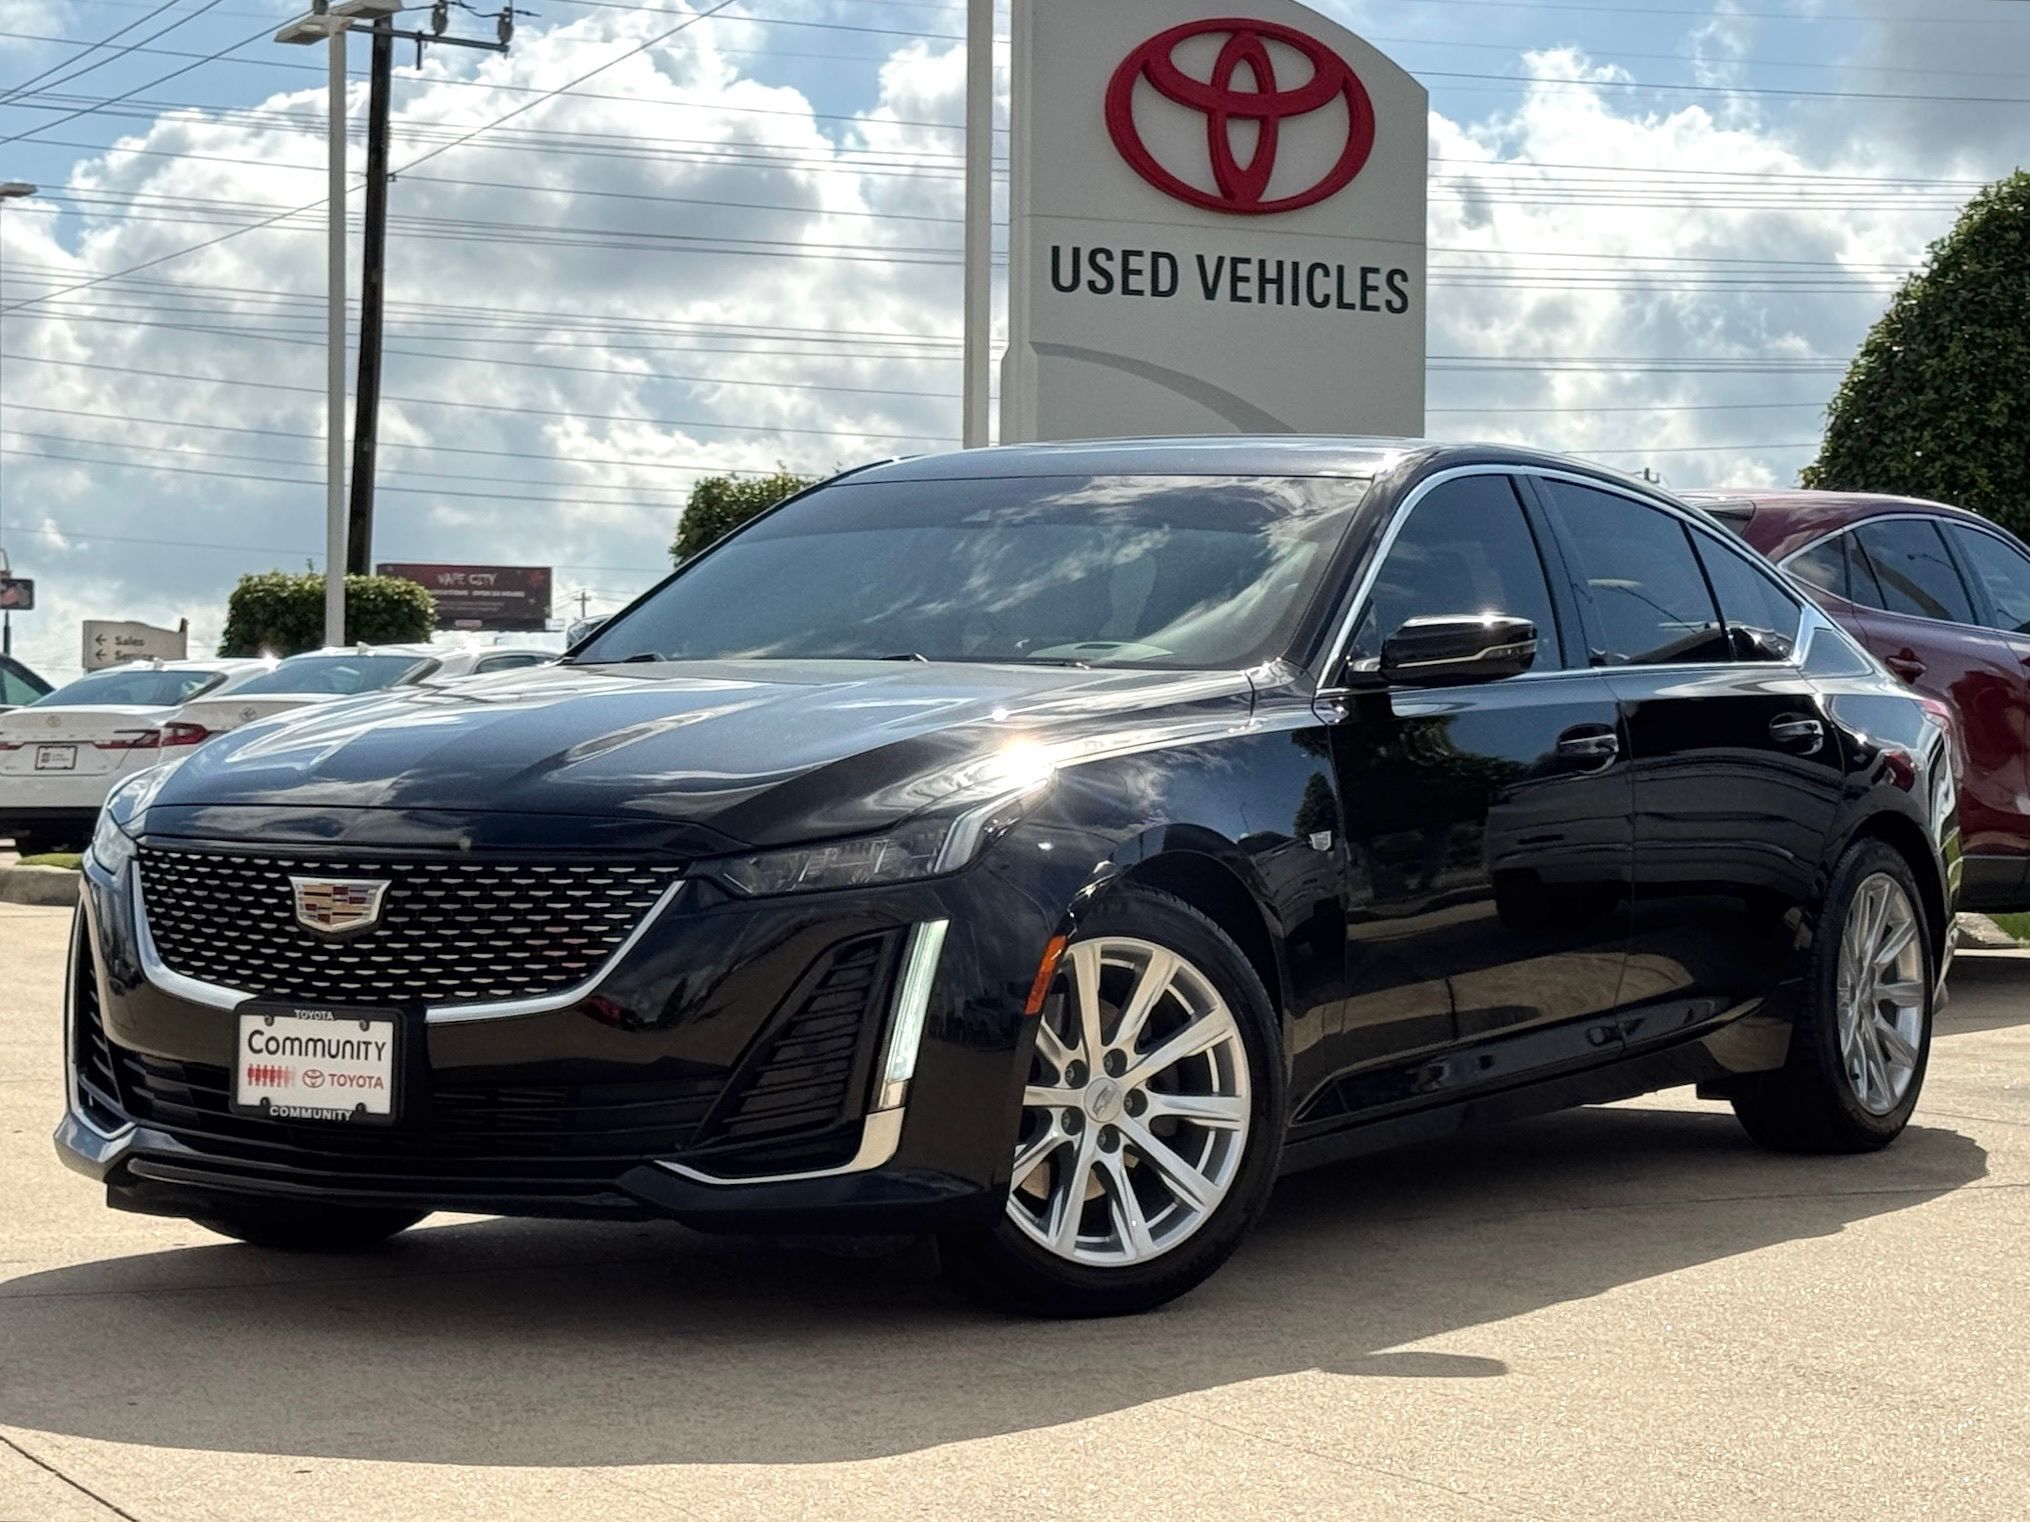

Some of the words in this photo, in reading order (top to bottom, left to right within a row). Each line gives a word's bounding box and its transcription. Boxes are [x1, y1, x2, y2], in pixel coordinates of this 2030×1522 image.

[1050, 245, 1179, 298] USED
[1196, 254, 1409, 314] VEHICLES
[468, 573, 498, 587] CITY
[115, 635, 145, 647] Sales
[294, 1009, 335, 1021] TOYOTA
[328, 1073, 384, 1089] TOYOTA
[269, 1106, 353, 1121] COMMUNITY
